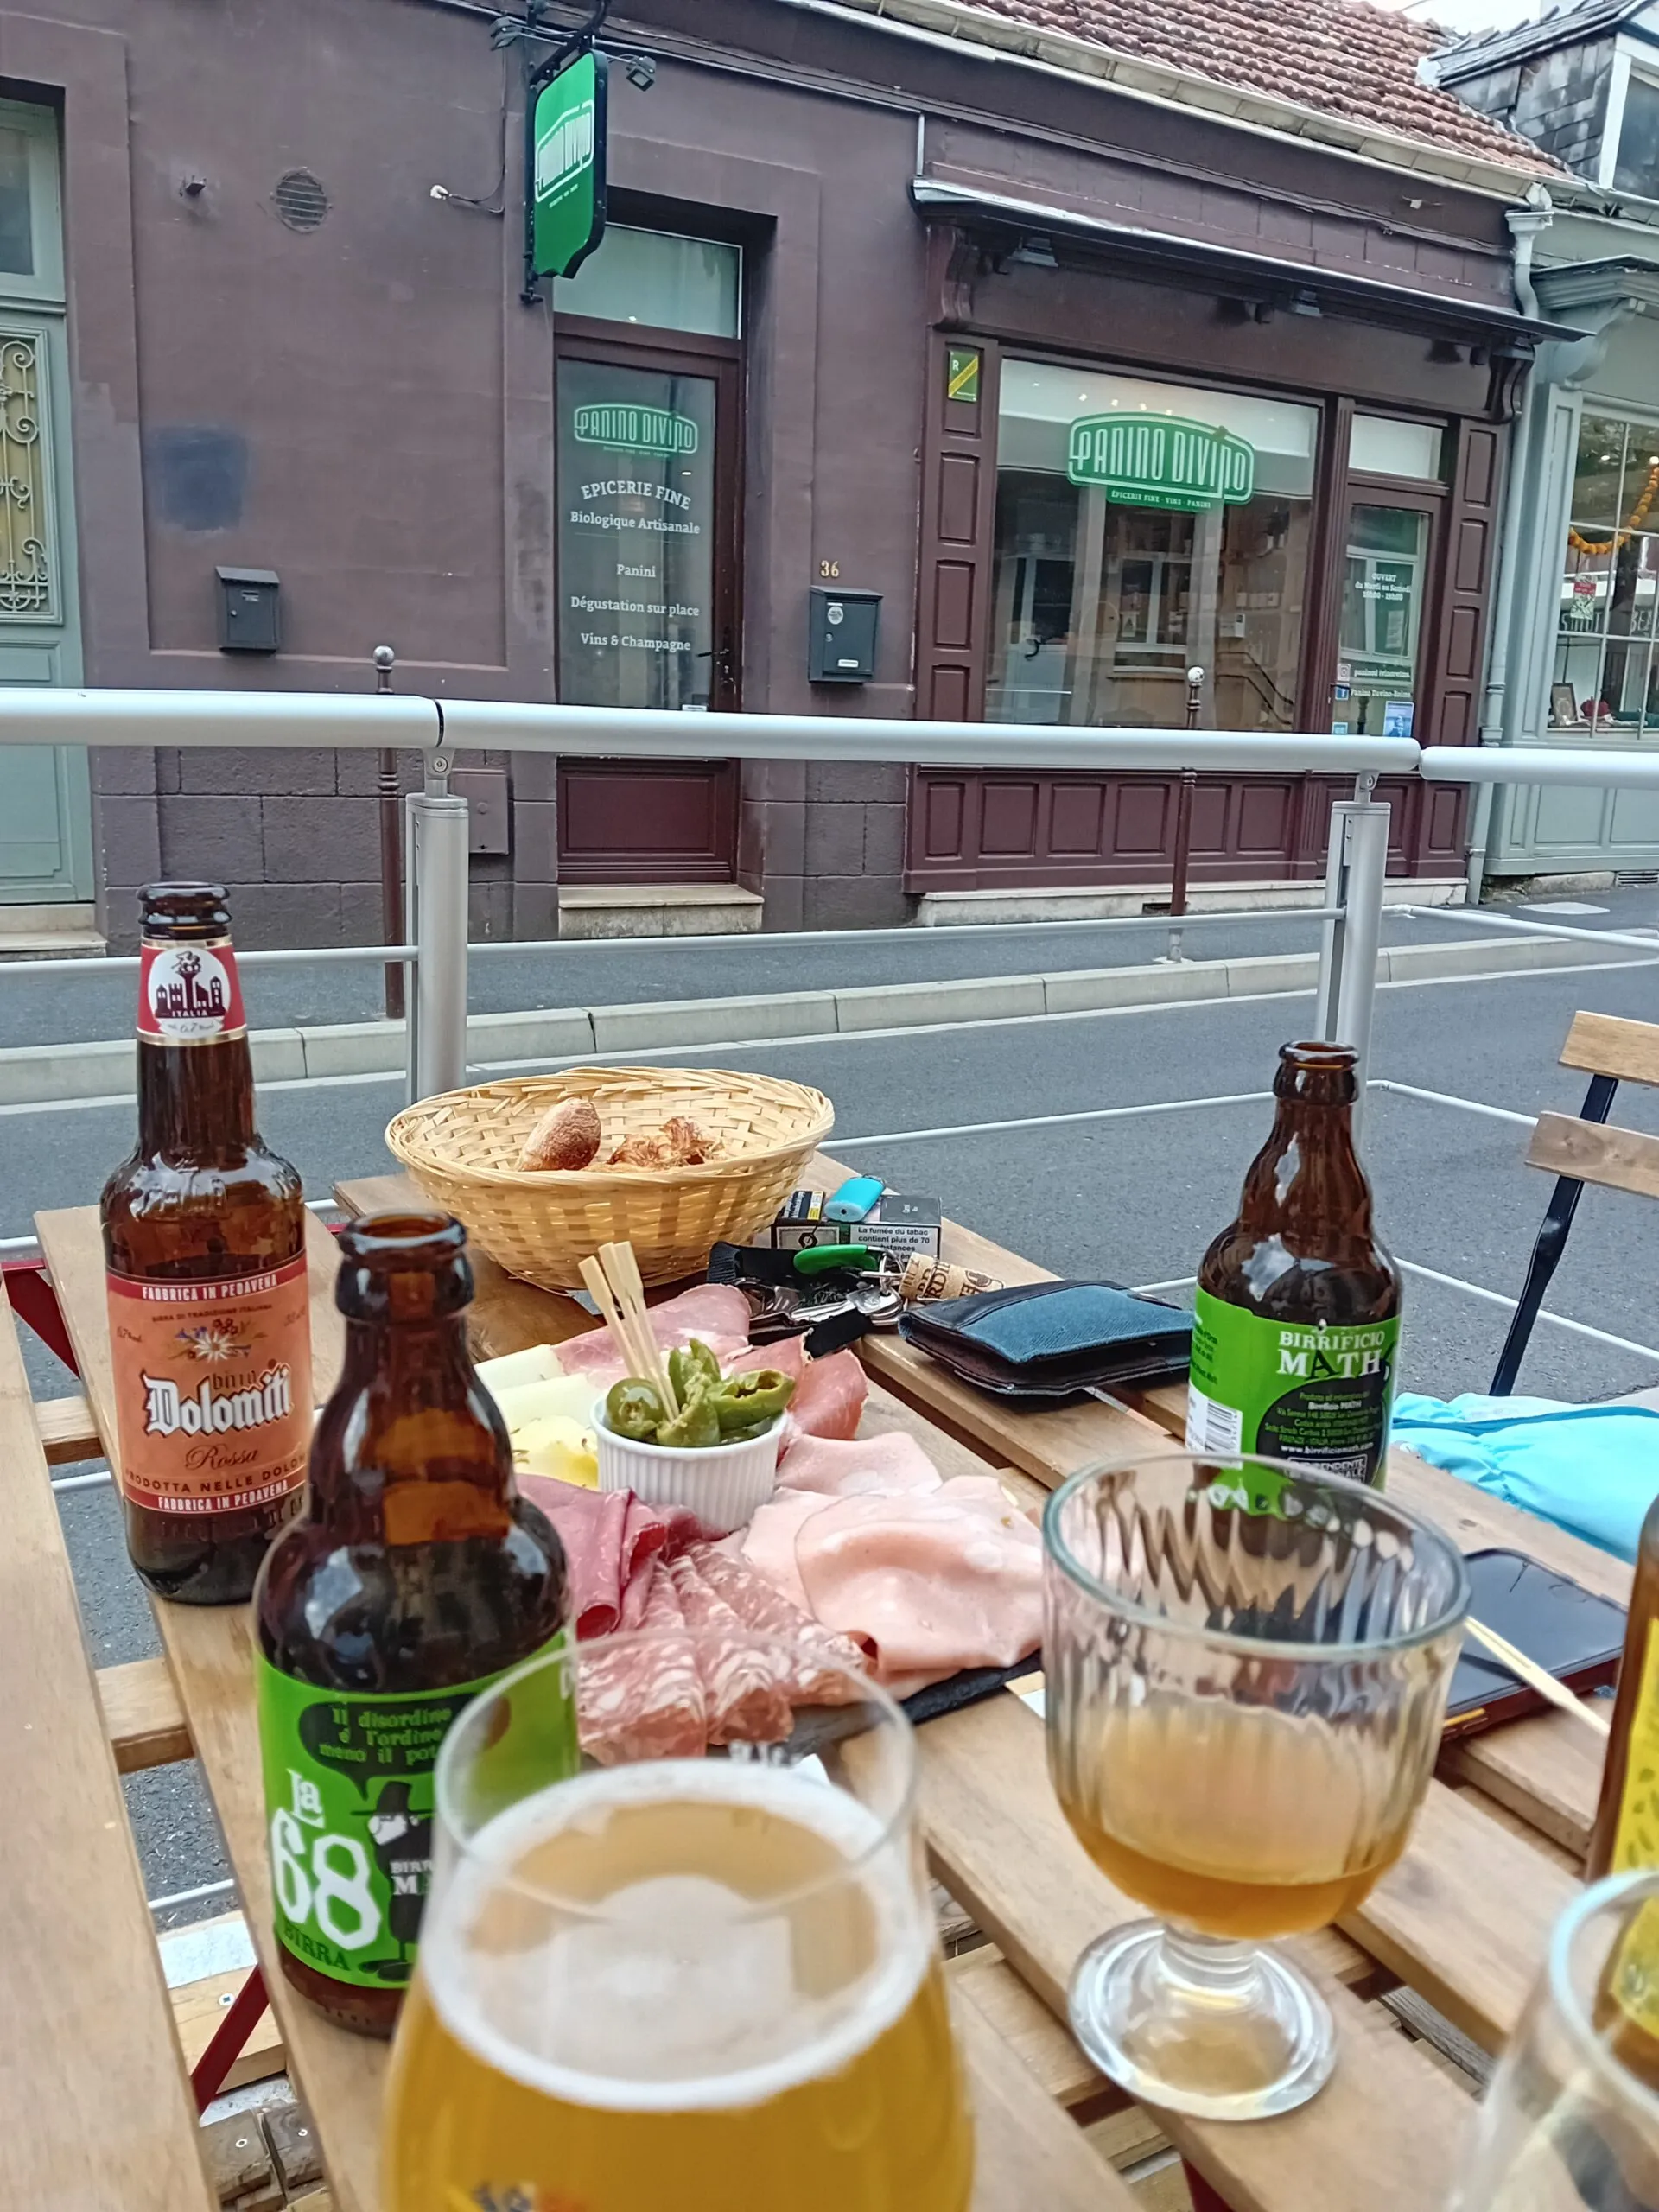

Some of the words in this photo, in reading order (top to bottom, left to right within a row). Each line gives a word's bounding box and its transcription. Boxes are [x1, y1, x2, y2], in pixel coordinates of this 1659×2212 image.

[580, 410, 637, 441] PANINO
[642, 413, 693, 450] DIVINO
[1077, 426, 1166, 480] PANINO
[1171, 430, 1247, 493] DIVINO
[580, 480, 652, 500] EPICERIE
[655, 485, 692, 511] FINE
[570, 511, 636, 530] Biologique
[638, 518, 701, 534] Artisanale
[616, 563, 657, 578] Panini
[821, 560, 840, 578] 36
[570, 595, 645, 612] Dégustation
[646, 604, 666, 614] sur
[668, 604, 700, 617] place
[581, 632, 608, 645] Vins
[610, 635, 619, 646] &
[621, 636, 691, 653] Champagne
[142, 1286, 198, 1301] FABBRICA
[202, 1287, 217, 1300] IN
[221, 1273, 277, 1298] PEDAVENA
[1279, 1330, 1385, 1351] BIRRIFICIO
[1276, 1348, 1382, 1380] MATH
[139, 1363, 291, 1438] Dolomiti
[185, 1443, 258, 1471] Rossa
[158, 1497, 213, 1511] FABBRICA
[217, 1496, 229, 1509] IN
[234, 1479, 289, 1506] PEDAVENA
[200, 1475, 253, 1492] NELLE
[358, 1707, 452, 1727] disordine
[319, 1743, 367, 1762] meno
[377, 1747, 392, 1764] il
[286, 1768, 325, 1829] La
[271, 1807, 383, 1951] 68
[283, 1918, 351, 1972] BIRRA
